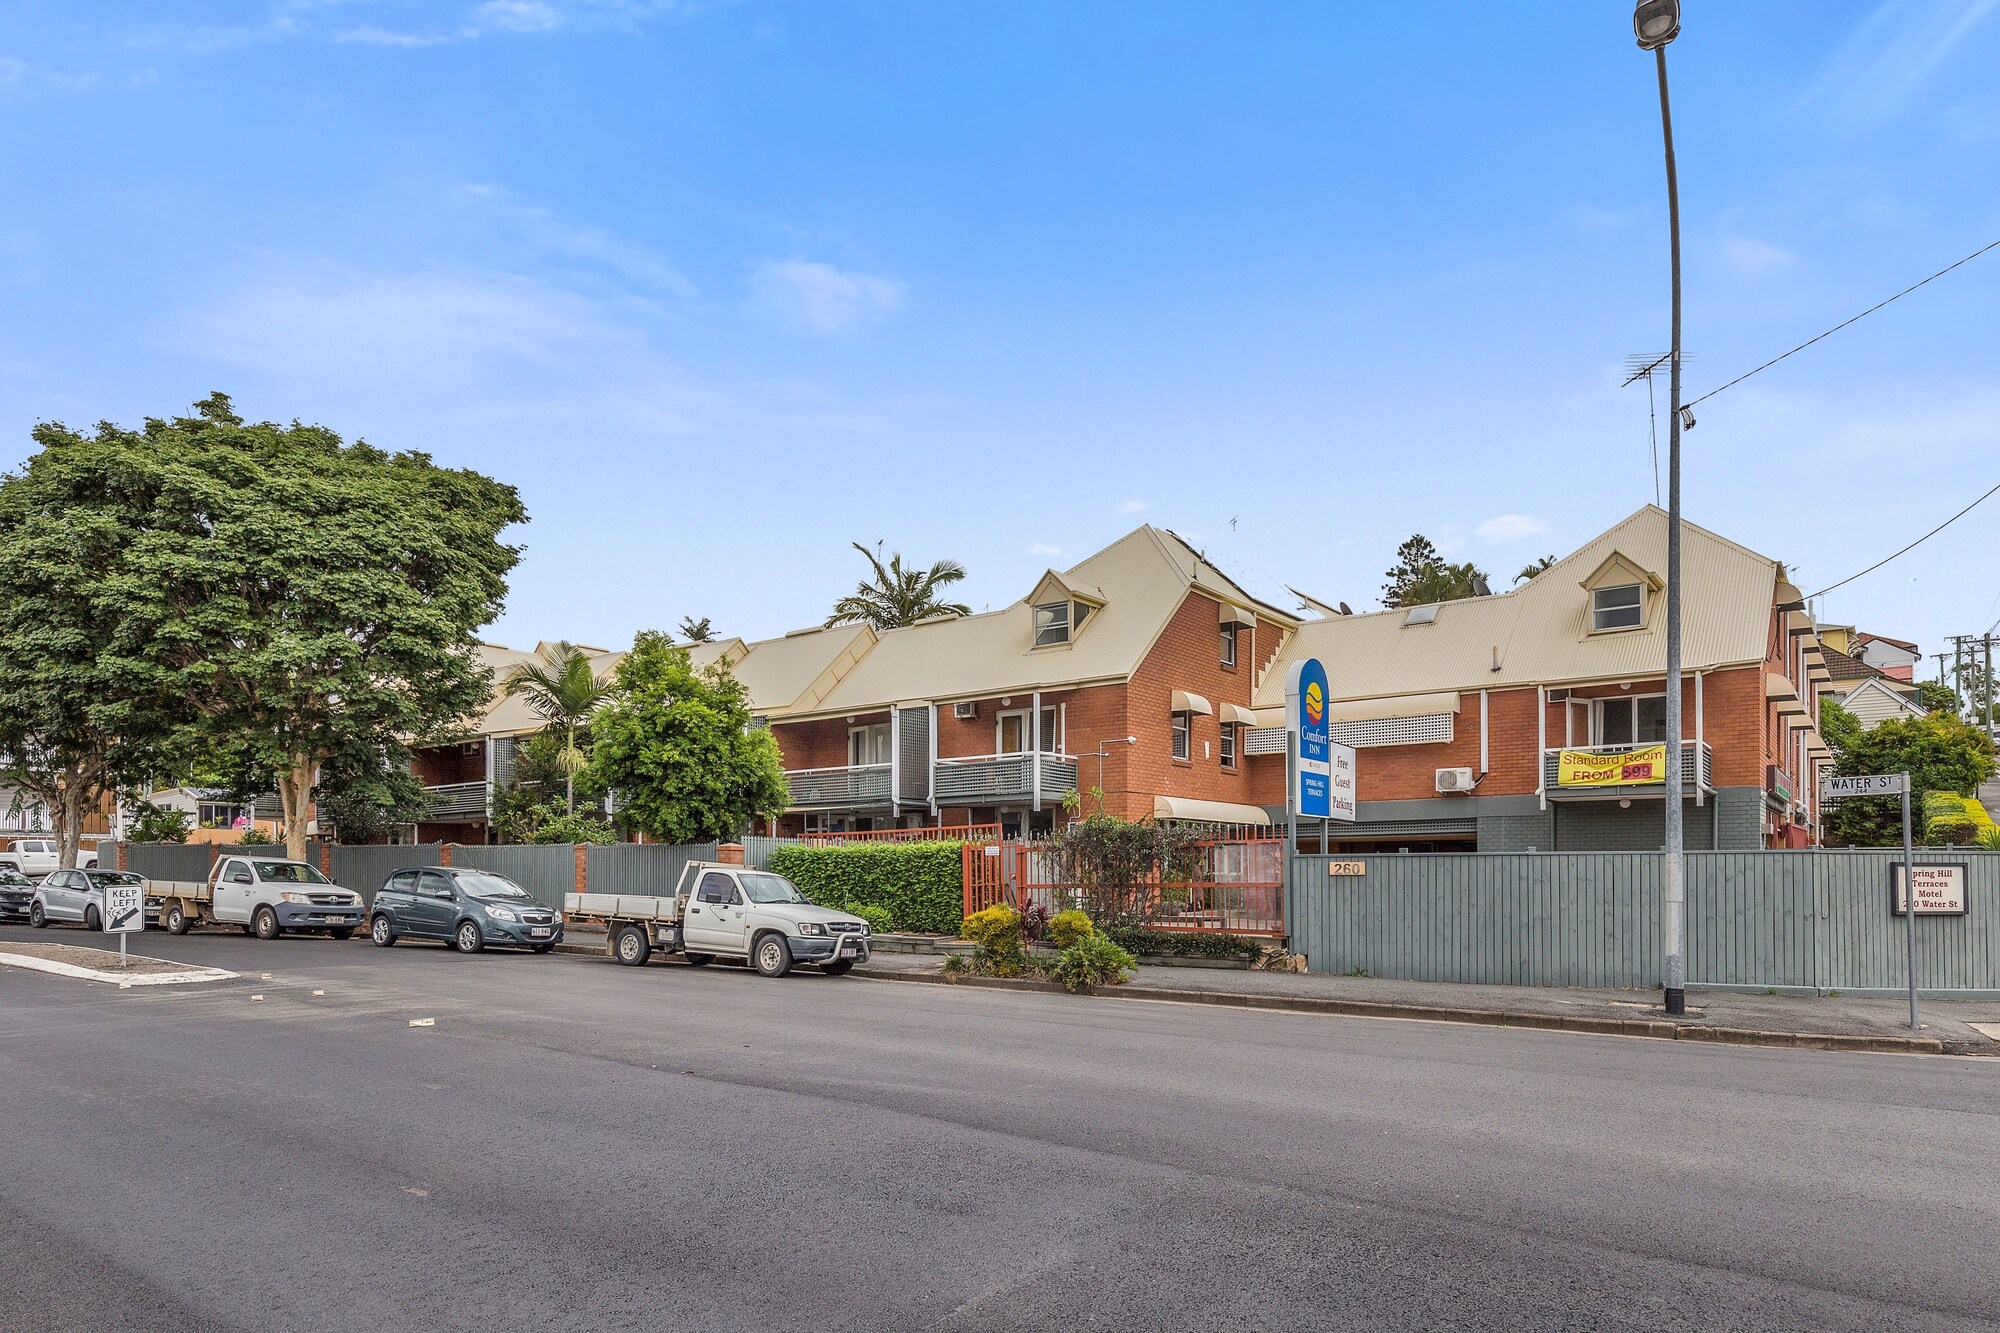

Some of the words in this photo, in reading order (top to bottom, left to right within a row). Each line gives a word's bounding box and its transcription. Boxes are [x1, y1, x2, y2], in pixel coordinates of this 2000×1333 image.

[1301, 725, 1328, 745] Comfort
[1309, 744, 1321, 755] INN
[1337, 755, 1349, 770] Free
[1563, 754, 1620, 766] Standard
[1624, 751, 1663, 764] Room
[1572, 769, 1615, 781] FROM
[1622, 765, 1651, 779] $99
[1334, 774, 1351, 789] Guest
[1830, 778, 1872, 790] WATER
[1879, 776, 1893, 788] ST
[1332, 795, 1354, 815] Parking
[1334, 863, 1360, 875] 260
[1912, 869, 1935, 879] pring
[1937, 869, 1953, 878] Hill
[1912, 879, 1949, 888] Terraces
[112, 889, 138, 898] KEEP
[1918, 890, 1943, 898] Motel
[113, 898, 137, 907] LEFT
[1902, 900, 1920, 908] 20
[1921, 900, 1947, 908] Water
[1948, 900, 1958, 908] St
